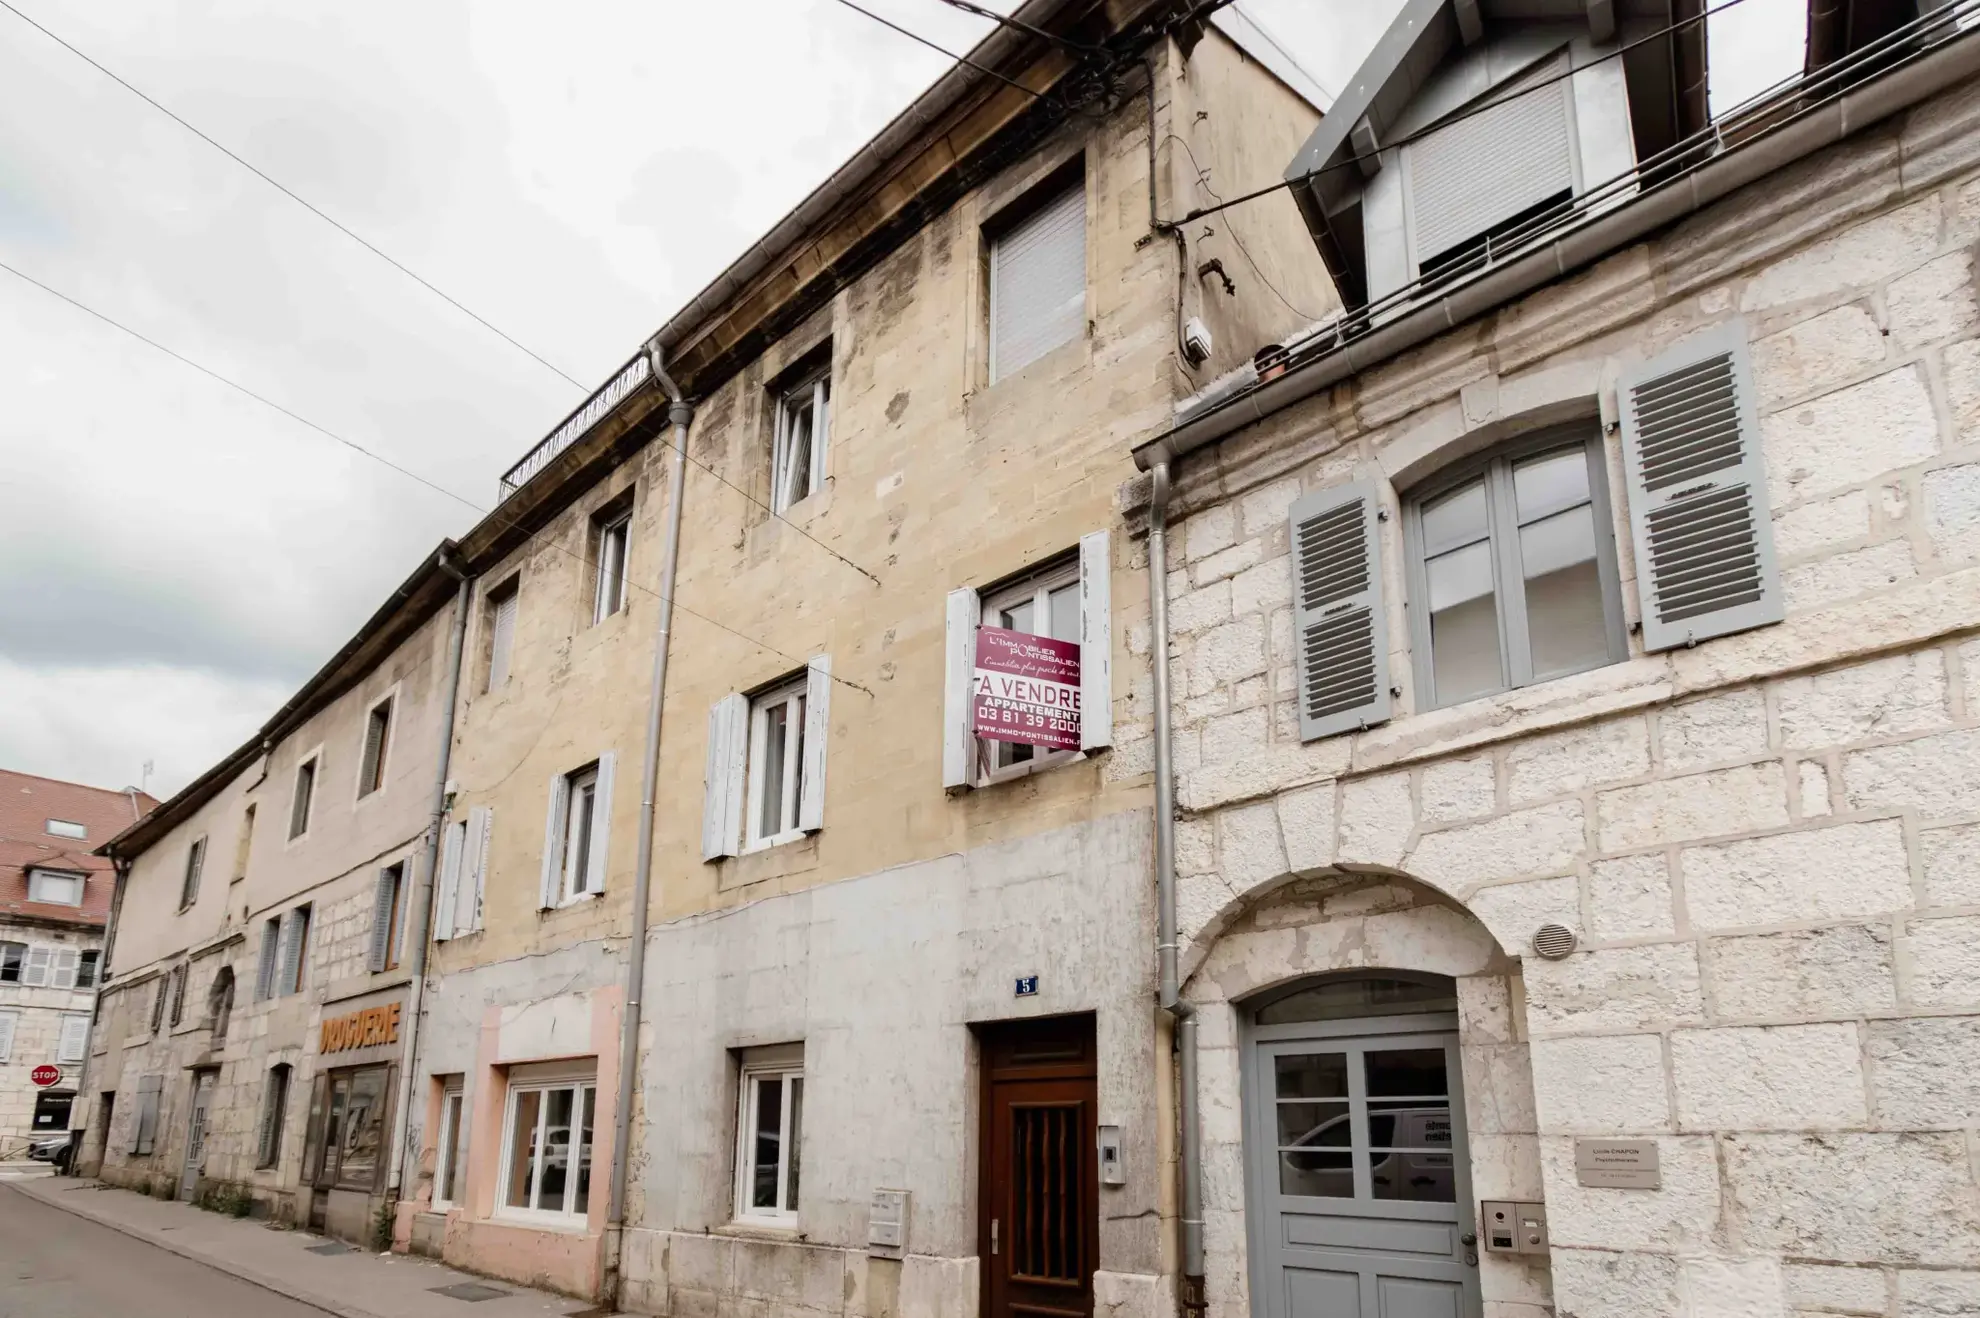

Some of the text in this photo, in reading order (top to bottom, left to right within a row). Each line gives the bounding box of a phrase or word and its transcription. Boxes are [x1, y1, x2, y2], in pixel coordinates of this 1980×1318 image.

[1010, 645, 1080, 667] PONTISSALIEN
[1020, 662, 1036, 674] plus
[1036, 664, 1057, 676] proche
[980, 675, 1080, 709] A VENDRE
[978, 707, 997, 720] 03
[1003, 711, 1019, 723] 81
[1026, 714, 1044, 727] 39
[985, 697, 1079, 721] APPARTEMENT
[1022, 979, 1030, 993] 5
[32, 1071, 57, 1079] STOP
